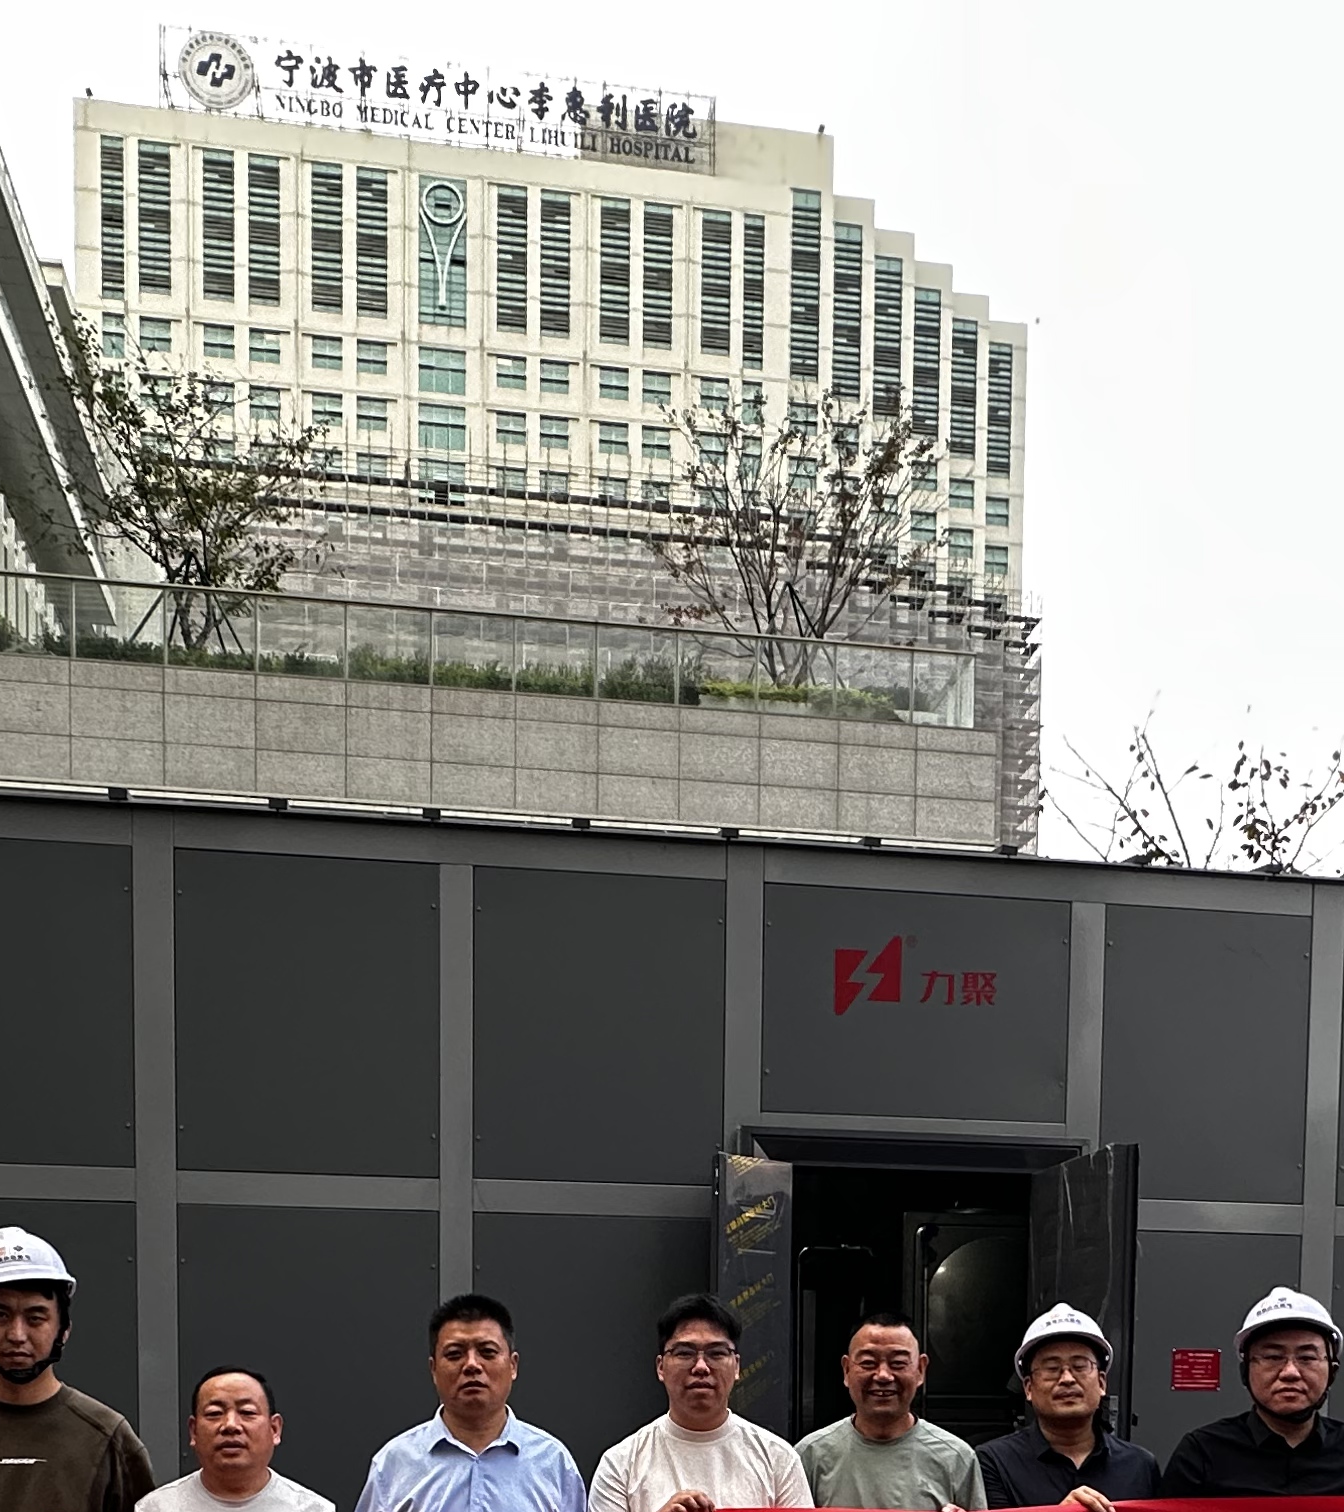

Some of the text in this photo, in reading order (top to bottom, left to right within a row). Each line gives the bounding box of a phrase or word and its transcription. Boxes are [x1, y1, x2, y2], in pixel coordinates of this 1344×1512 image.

[274, 50, 698, 139] 宁波市医疗中心李惠利医院
[275, 94, 696, 165] NINGBO MEDICAL CENTER LIHUILI HOSPITAL
[919, 970, 998, 1006] 力聚
